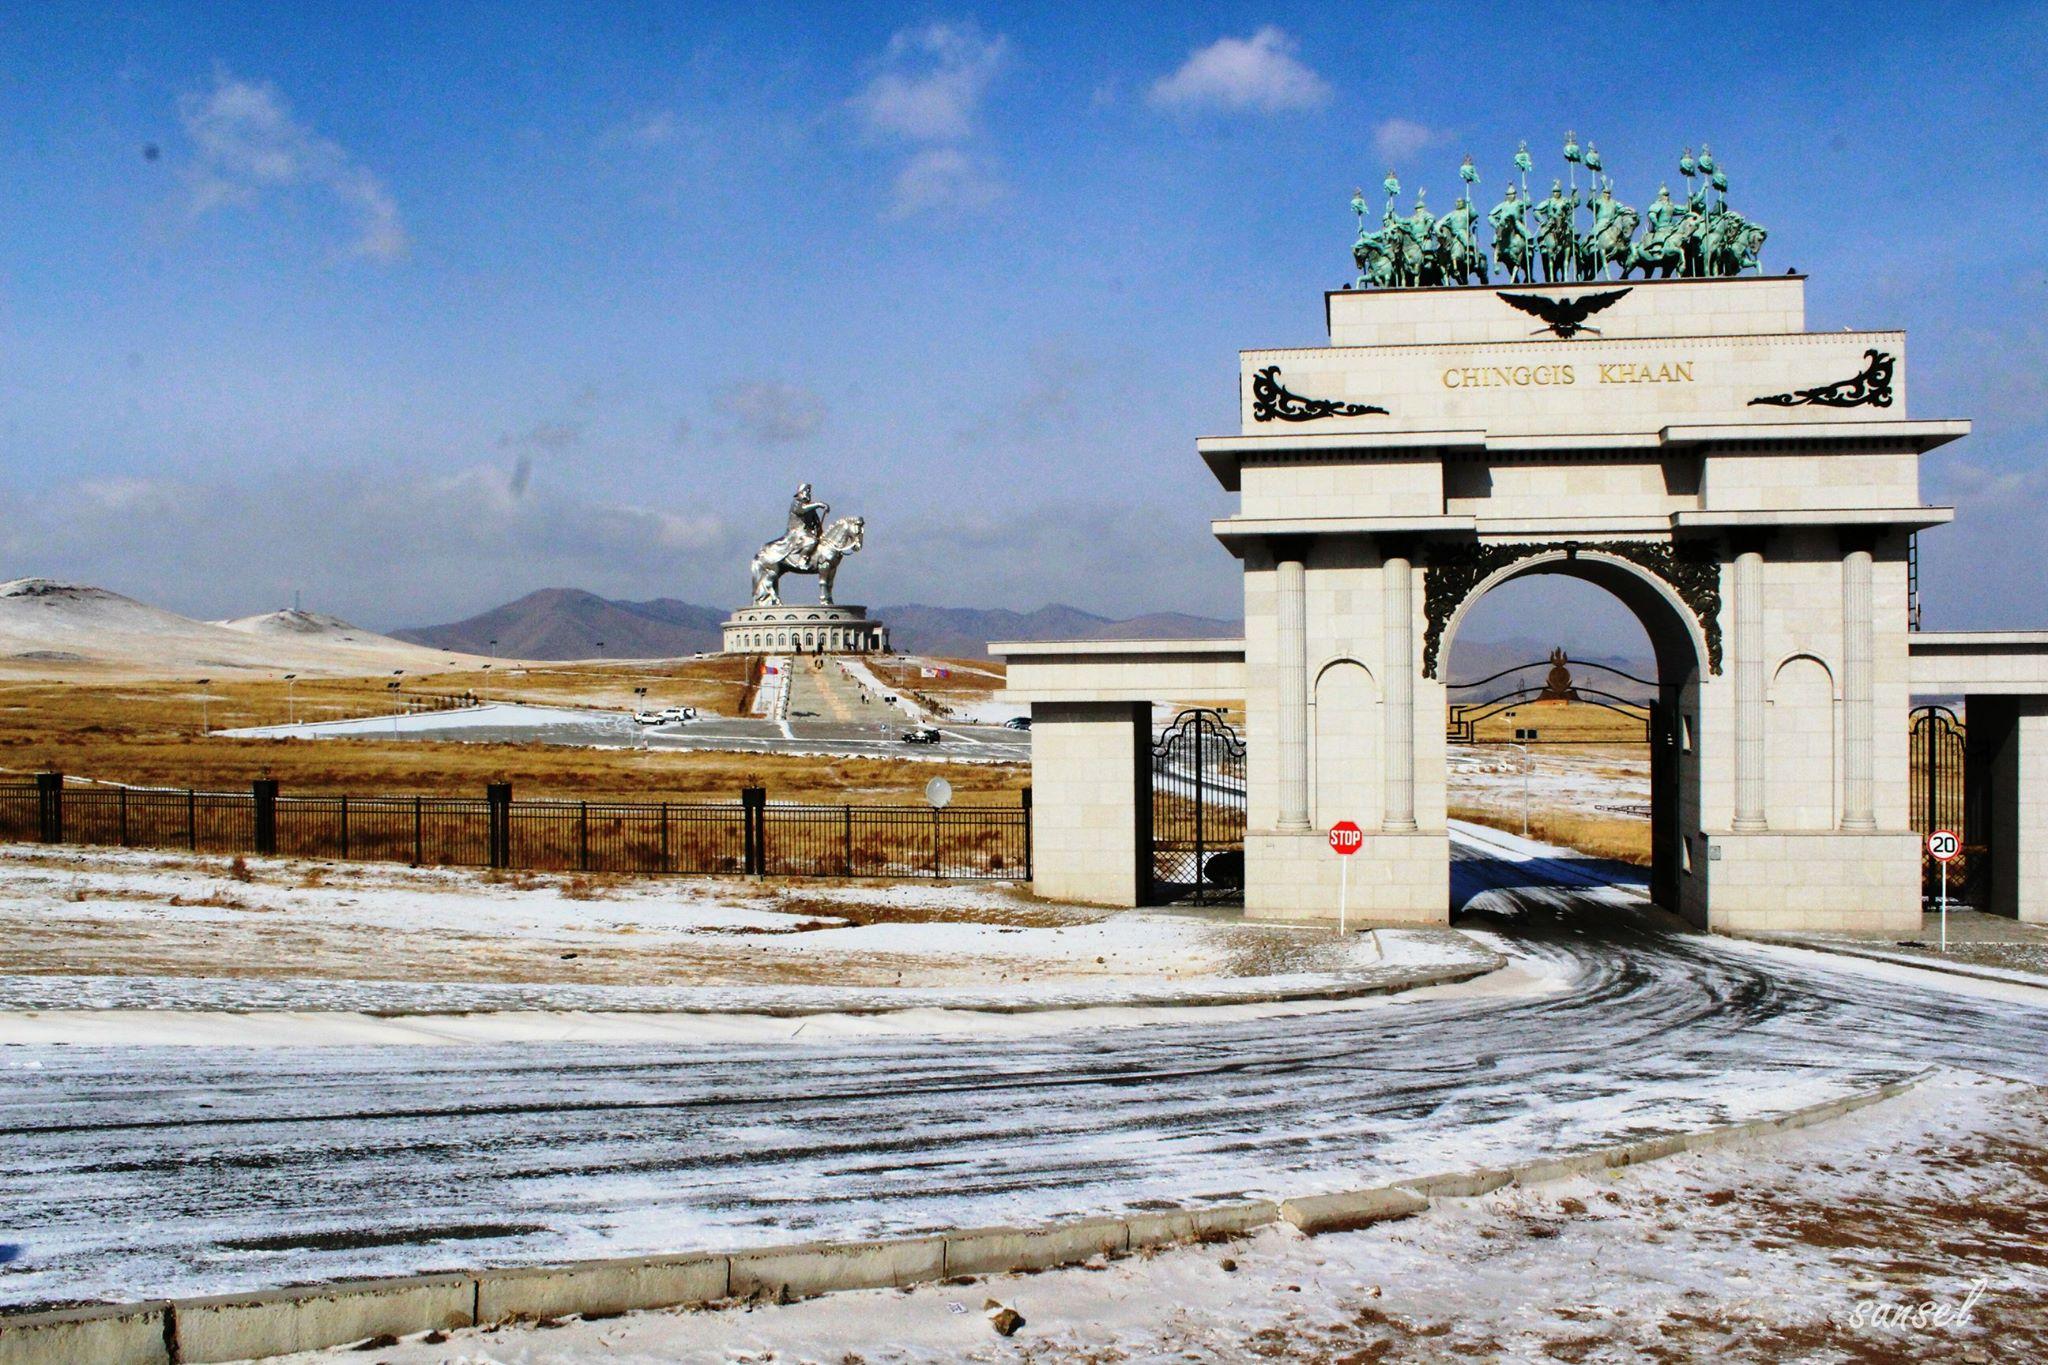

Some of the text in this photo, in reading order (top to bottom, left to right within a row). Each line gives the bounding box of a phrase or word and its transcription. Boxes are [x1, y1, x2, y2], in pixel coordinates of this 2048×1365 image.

[1442, 361, 1694, 388] CHINGGIS KHAAN
[1331, 830, 1360, 845] STOP
[1933, 837, 1955, 852] 20
